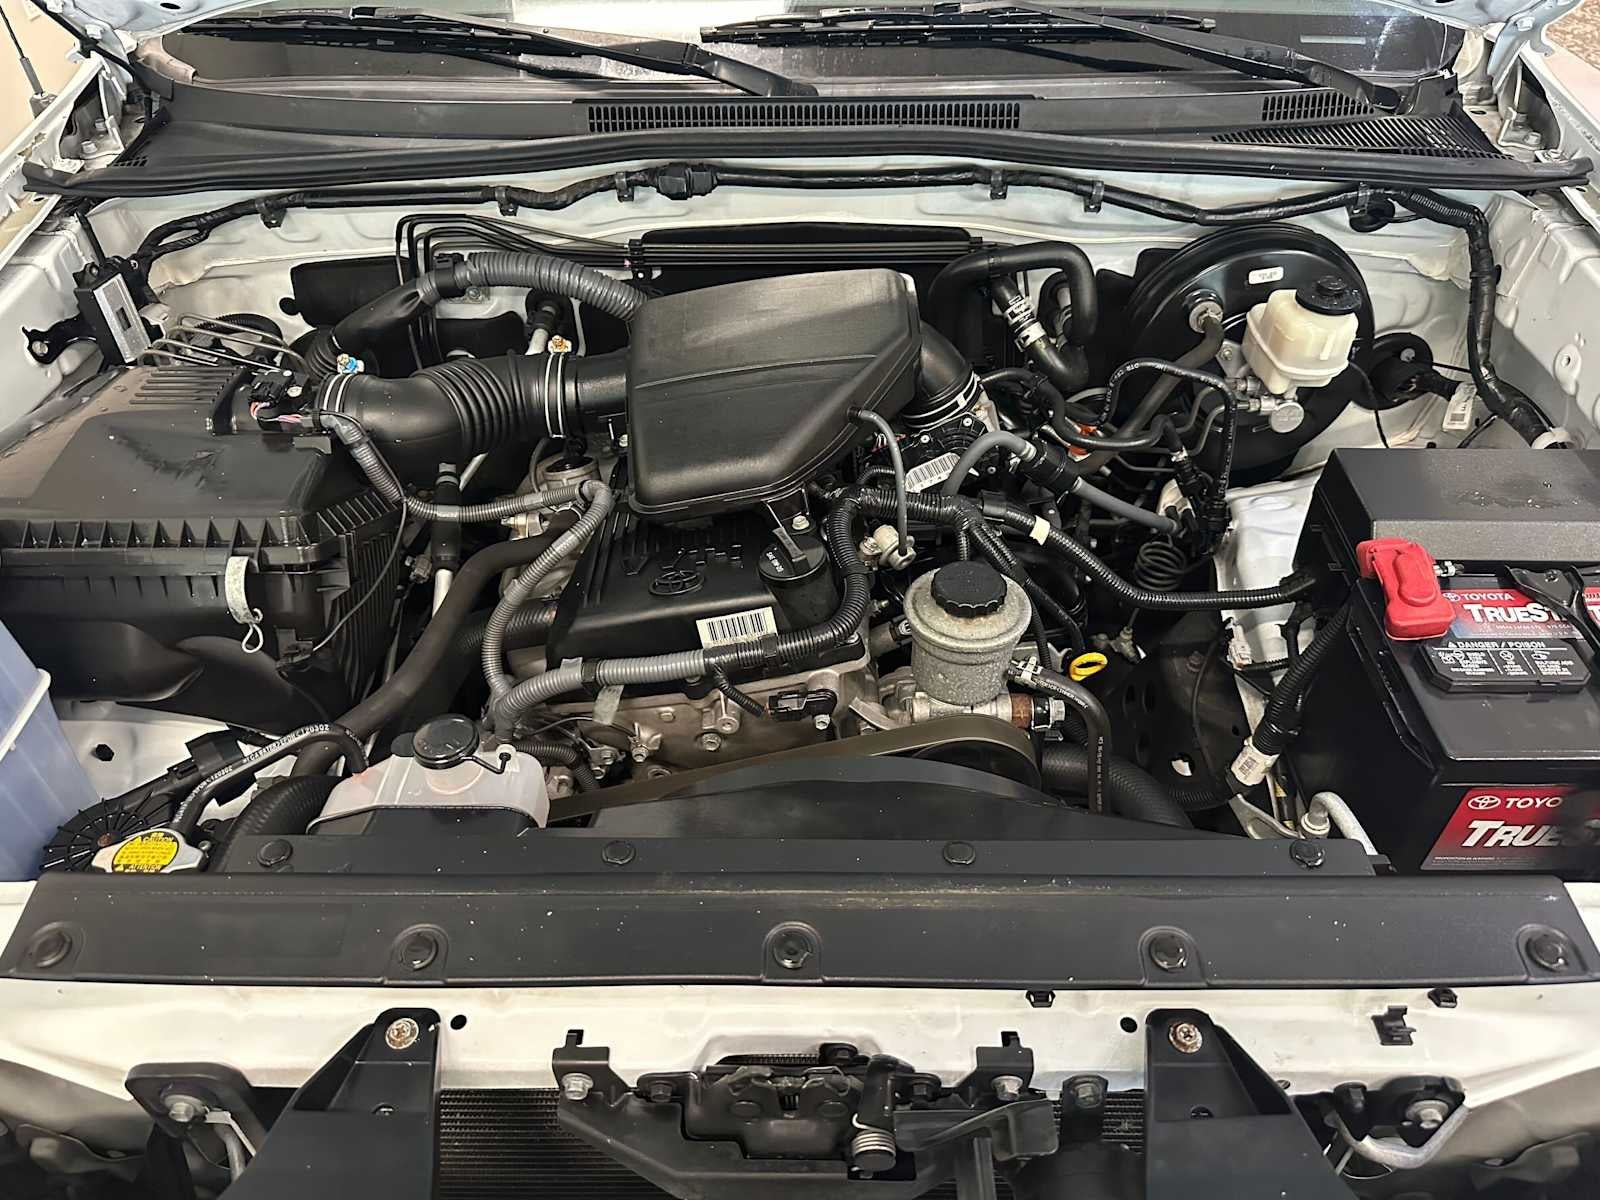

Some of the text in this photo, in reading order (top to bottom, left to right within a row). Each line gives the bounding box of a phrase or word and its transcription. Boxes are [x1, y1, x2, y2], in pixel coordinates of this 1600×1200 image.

[1460, 592, 1514, 601] TOYOTA
[1462, 602, 1567, 623] TRUEST
[1457, 641, 1498, 649] DANGER
[1509, 641, 1546, 649] POISON
[1505, 796, 1564, 809] TOYO
[1461, 819, 1561, 848] TRUE
